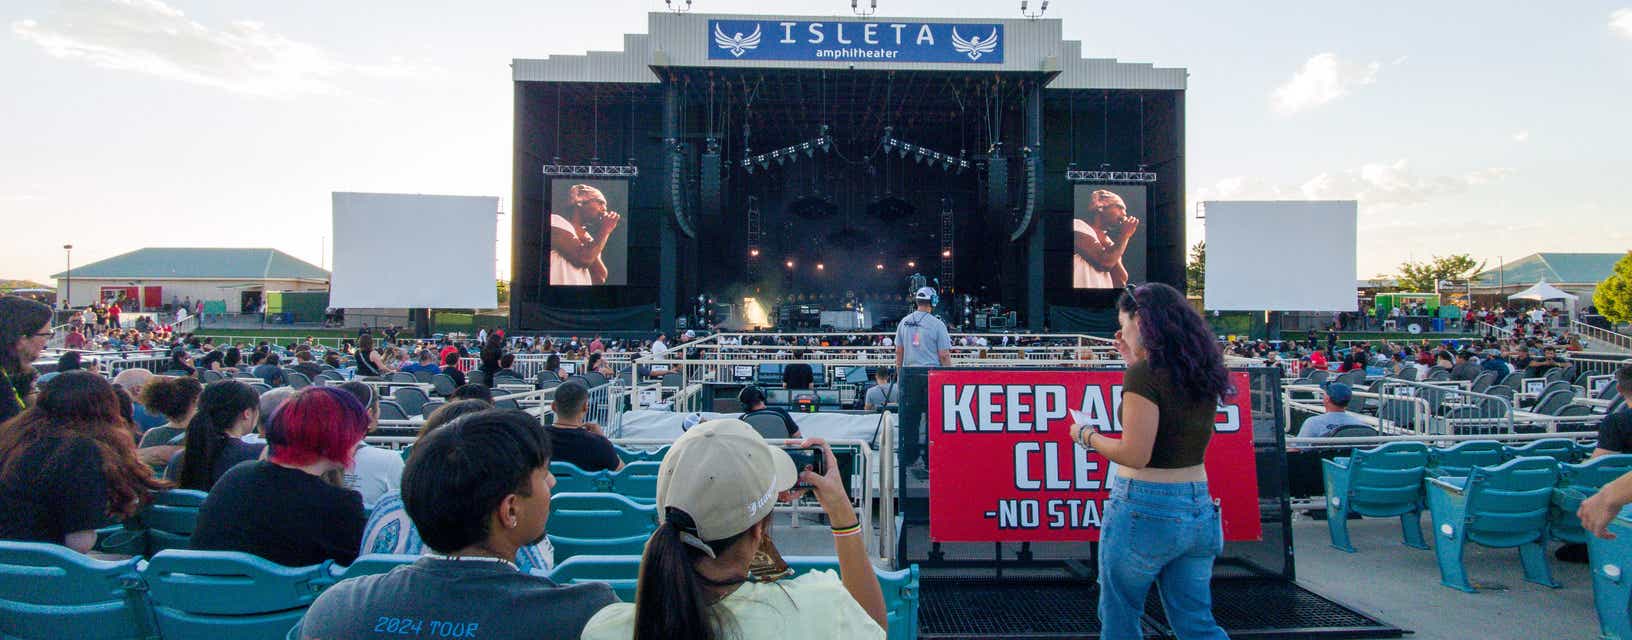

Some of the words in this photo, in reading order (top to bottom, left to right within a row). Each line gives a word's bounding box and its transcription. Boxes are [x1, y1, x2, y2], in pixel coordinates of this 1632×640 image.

[779, 22, 935, 45] ISLETA
[816, 48, 899, 59] amphitheater
[942, 384, 1068, 433] KEEP
[374, 616, 423, 635] 2024
[430, 620, 479, 638] TOUR
